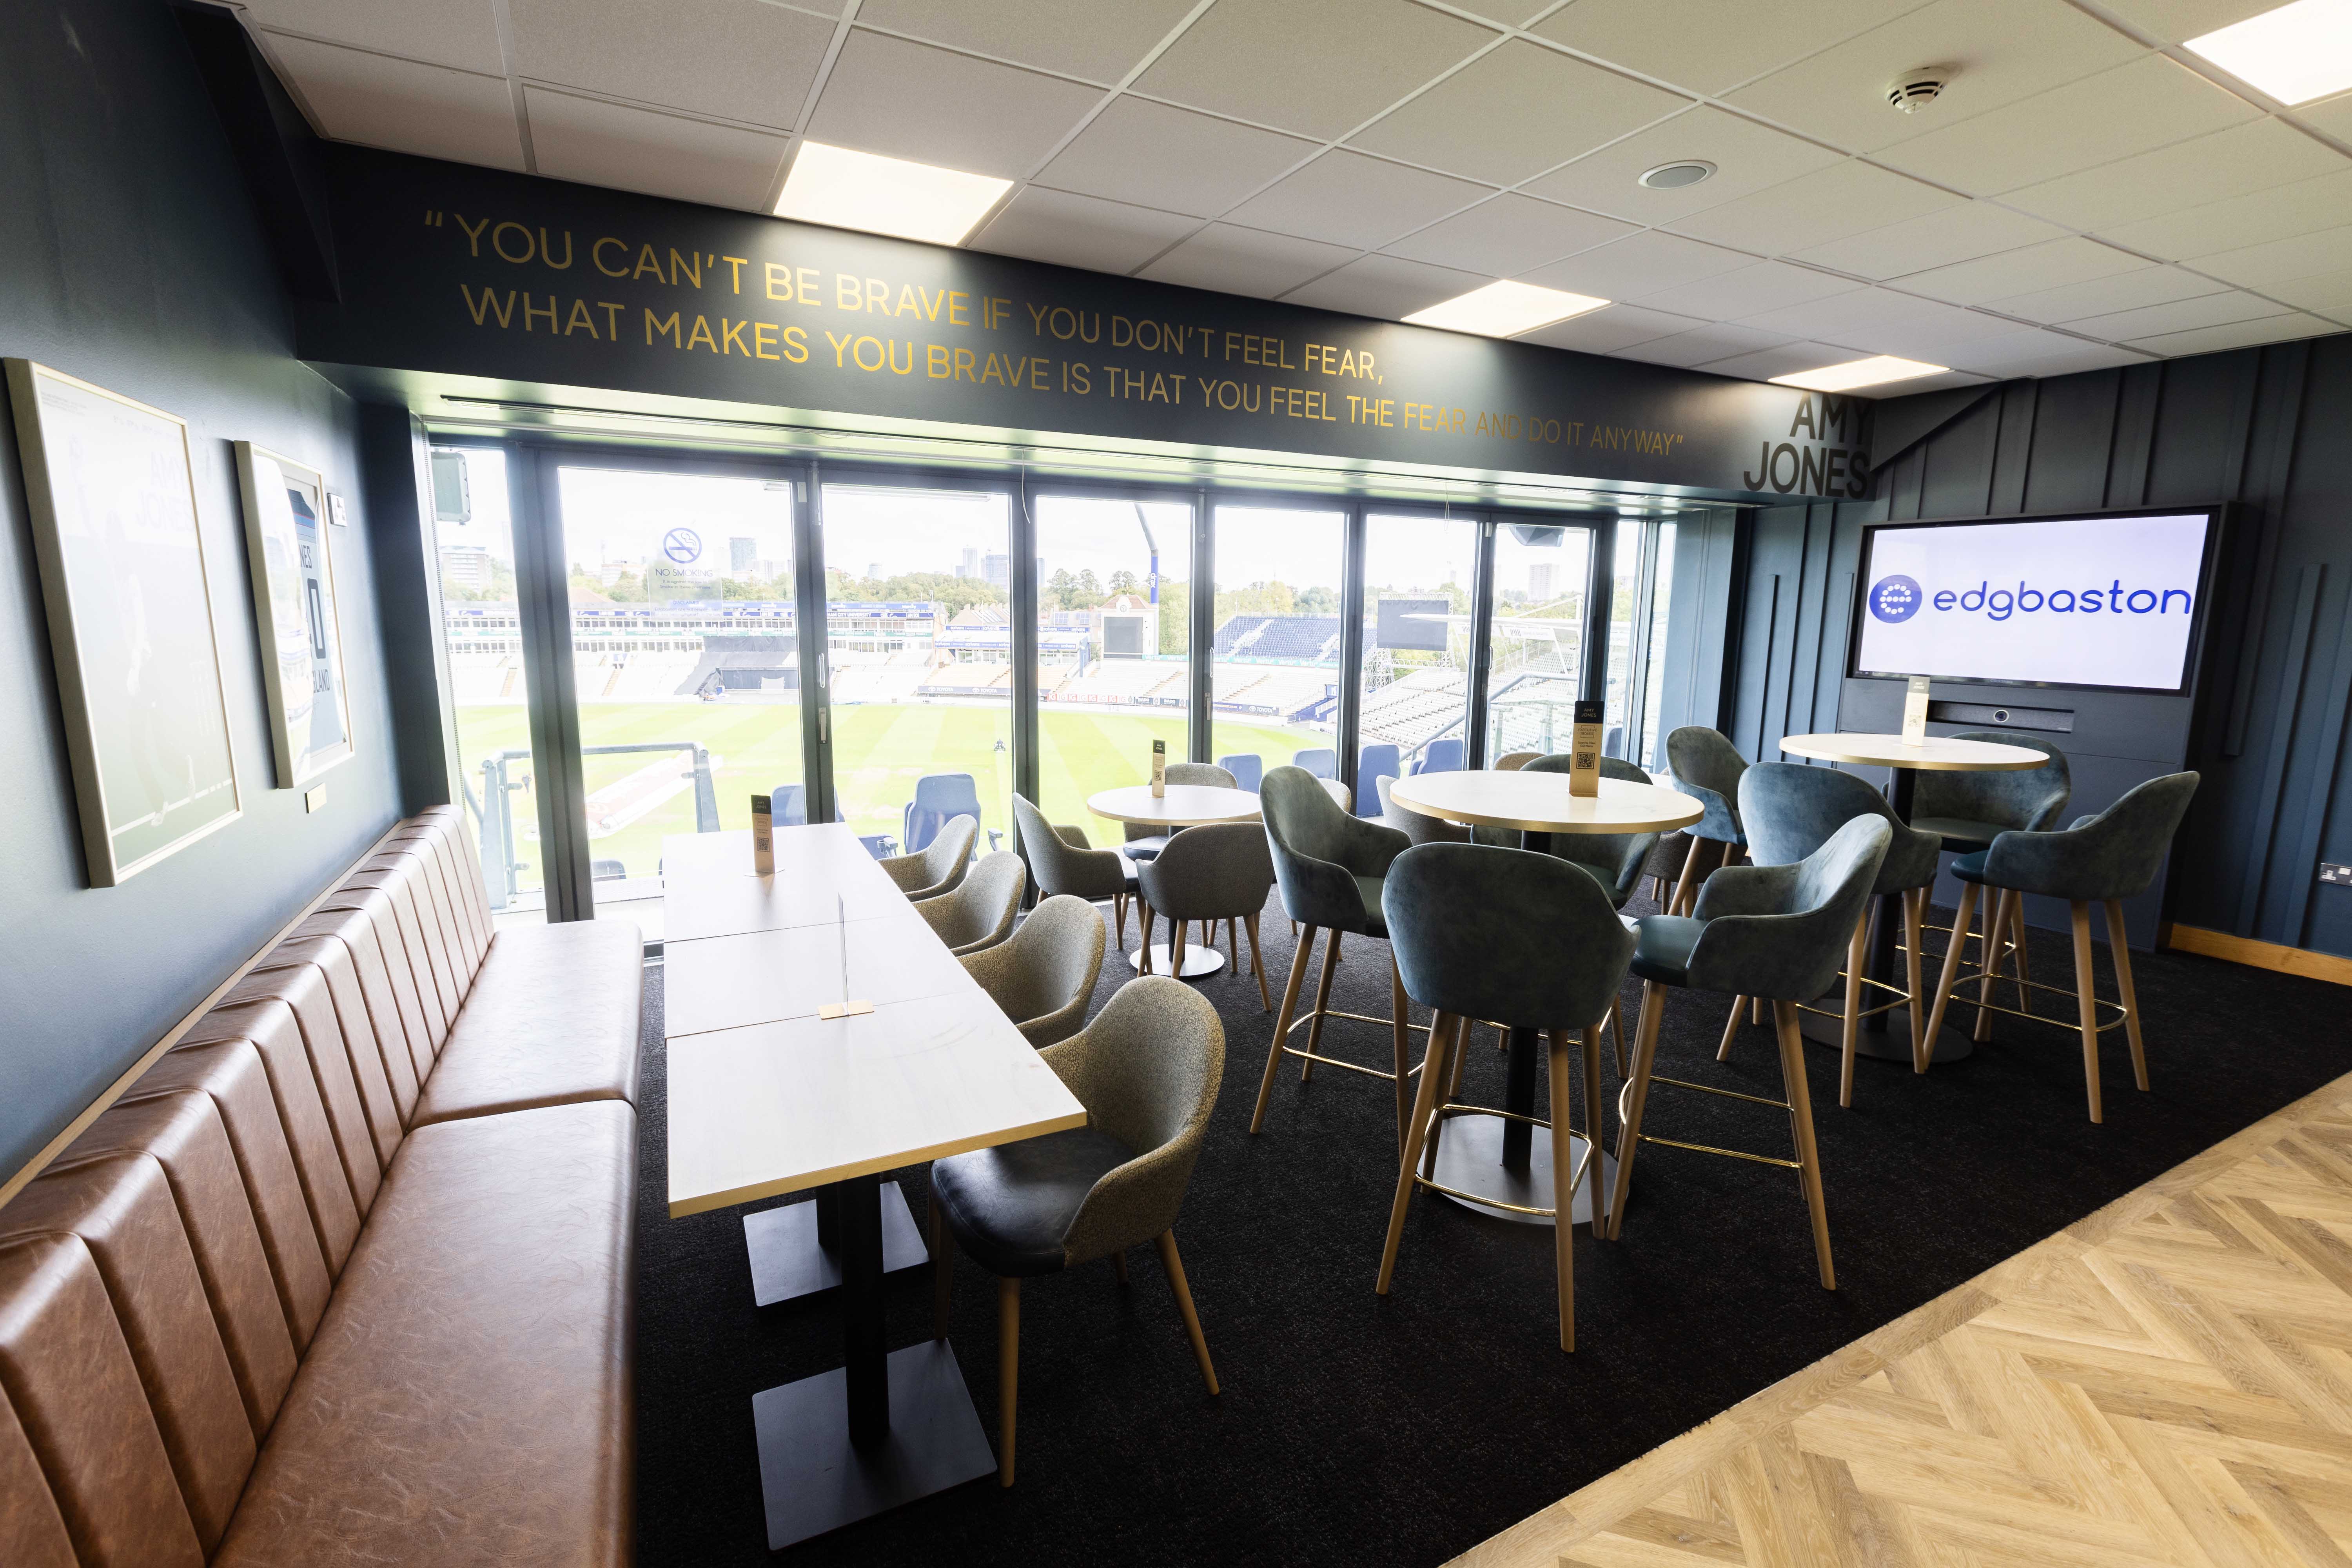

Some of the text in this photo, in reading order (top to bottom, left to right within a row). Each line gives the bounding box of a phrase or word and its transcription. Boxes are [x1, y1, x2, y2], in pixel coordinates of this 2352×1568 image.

[593, 237, 748, 295] CAN'T
[766, 263, 821, 307] BE
[836, 273, 970, 326] BRAVE
[983, 296, 1012, 330] IF
[1027, 303, 1100, 343] YOU
[1112, 316, 1215, 358] DON'T
[1226, 332, 1295, 370] FEEL
[1305, 343, 1383, 386] FEAR,
[461, 284, 625, 342] WHAT
[645, 308, 809, 364] MAKES
[825, 331, 913, 376] YOU
[927, 345, 1050, 392] BRAVE
[1063, 361, 1091, 395] IS
[1104, 366, 1186, 405] THAT
[1198, 377, 1261, 413] YOU
[1271, 387, 1336, 421] FEEL
[1346, 395, 1394, 428] THE
[1405, 402, 1466, 434] FEAR
[1475, 411, 1522, 441] AND
[1529, 416, 1561, 445] DO
[1568, 421, 1584, 446] IT
[1789, 393, 1875, 445] AMY
[1743, 440, 1871, 499] JONES
[299, 544, 312, 568] NES
[673, 569, 713, 577] SMOKING
[307, 578, 326, 659] 0
[1933, 580, 2193, 621] edgbaston
[312, 669, 330, 693] LAND
